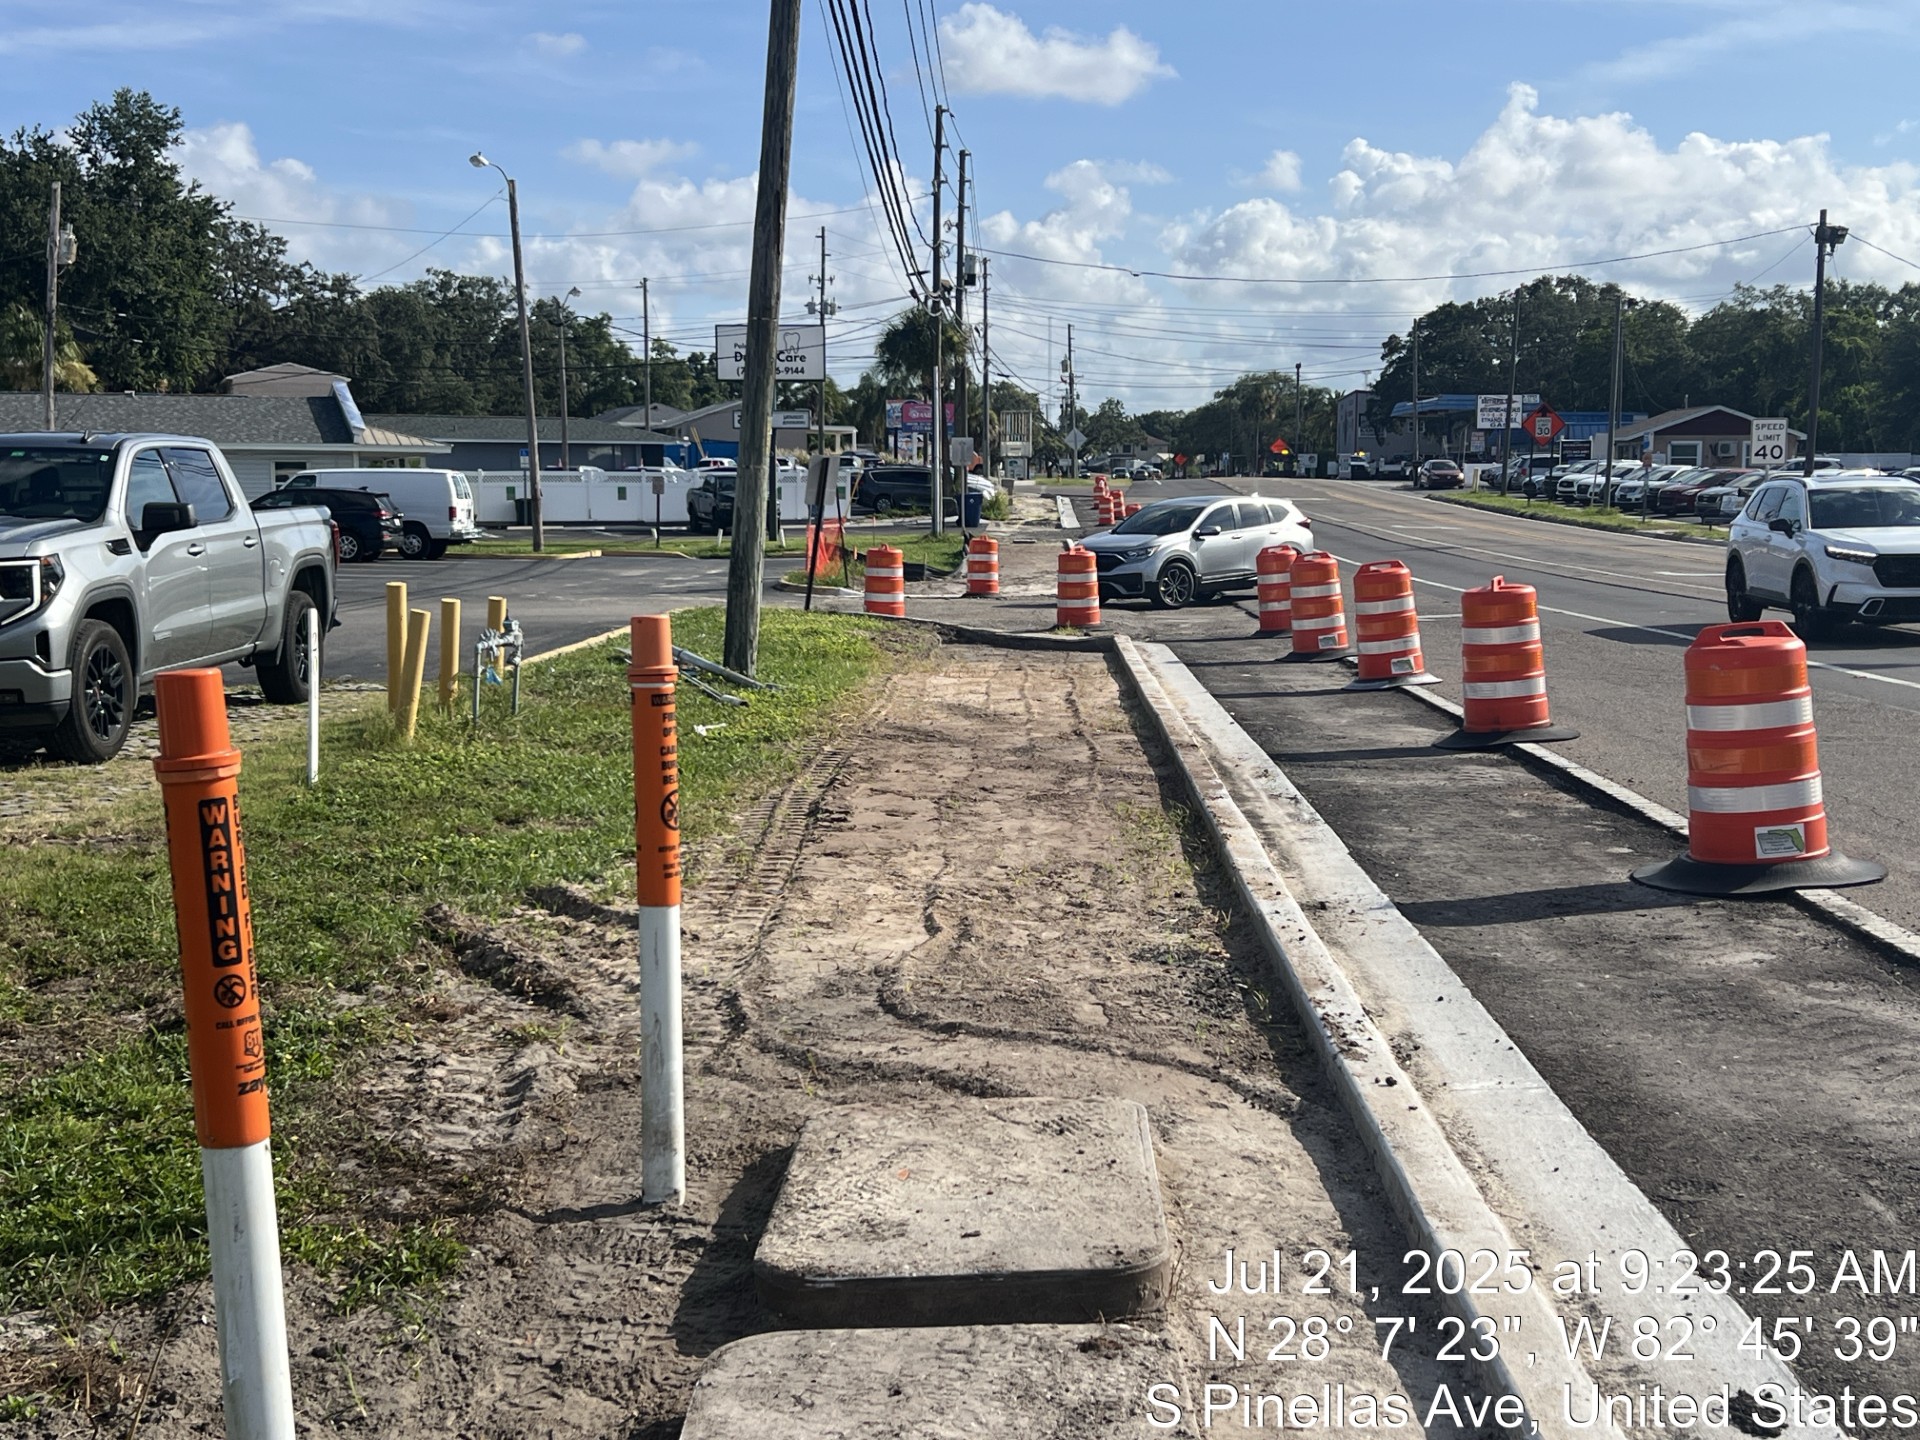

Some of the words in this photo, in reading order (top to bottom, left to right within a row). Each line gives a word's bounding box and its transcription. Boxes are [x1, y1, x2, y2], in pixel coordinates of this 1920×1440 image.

[777, 352, 806, 362] Care
[1537, 427, 1550, 435] 30
[1755, 423, 1785, 431] SPEED
[1757, 433, 1781, 441] LIMIT
[1754, 445, 1783, 459] 40
[202, 804, 237, 960] WARNING
